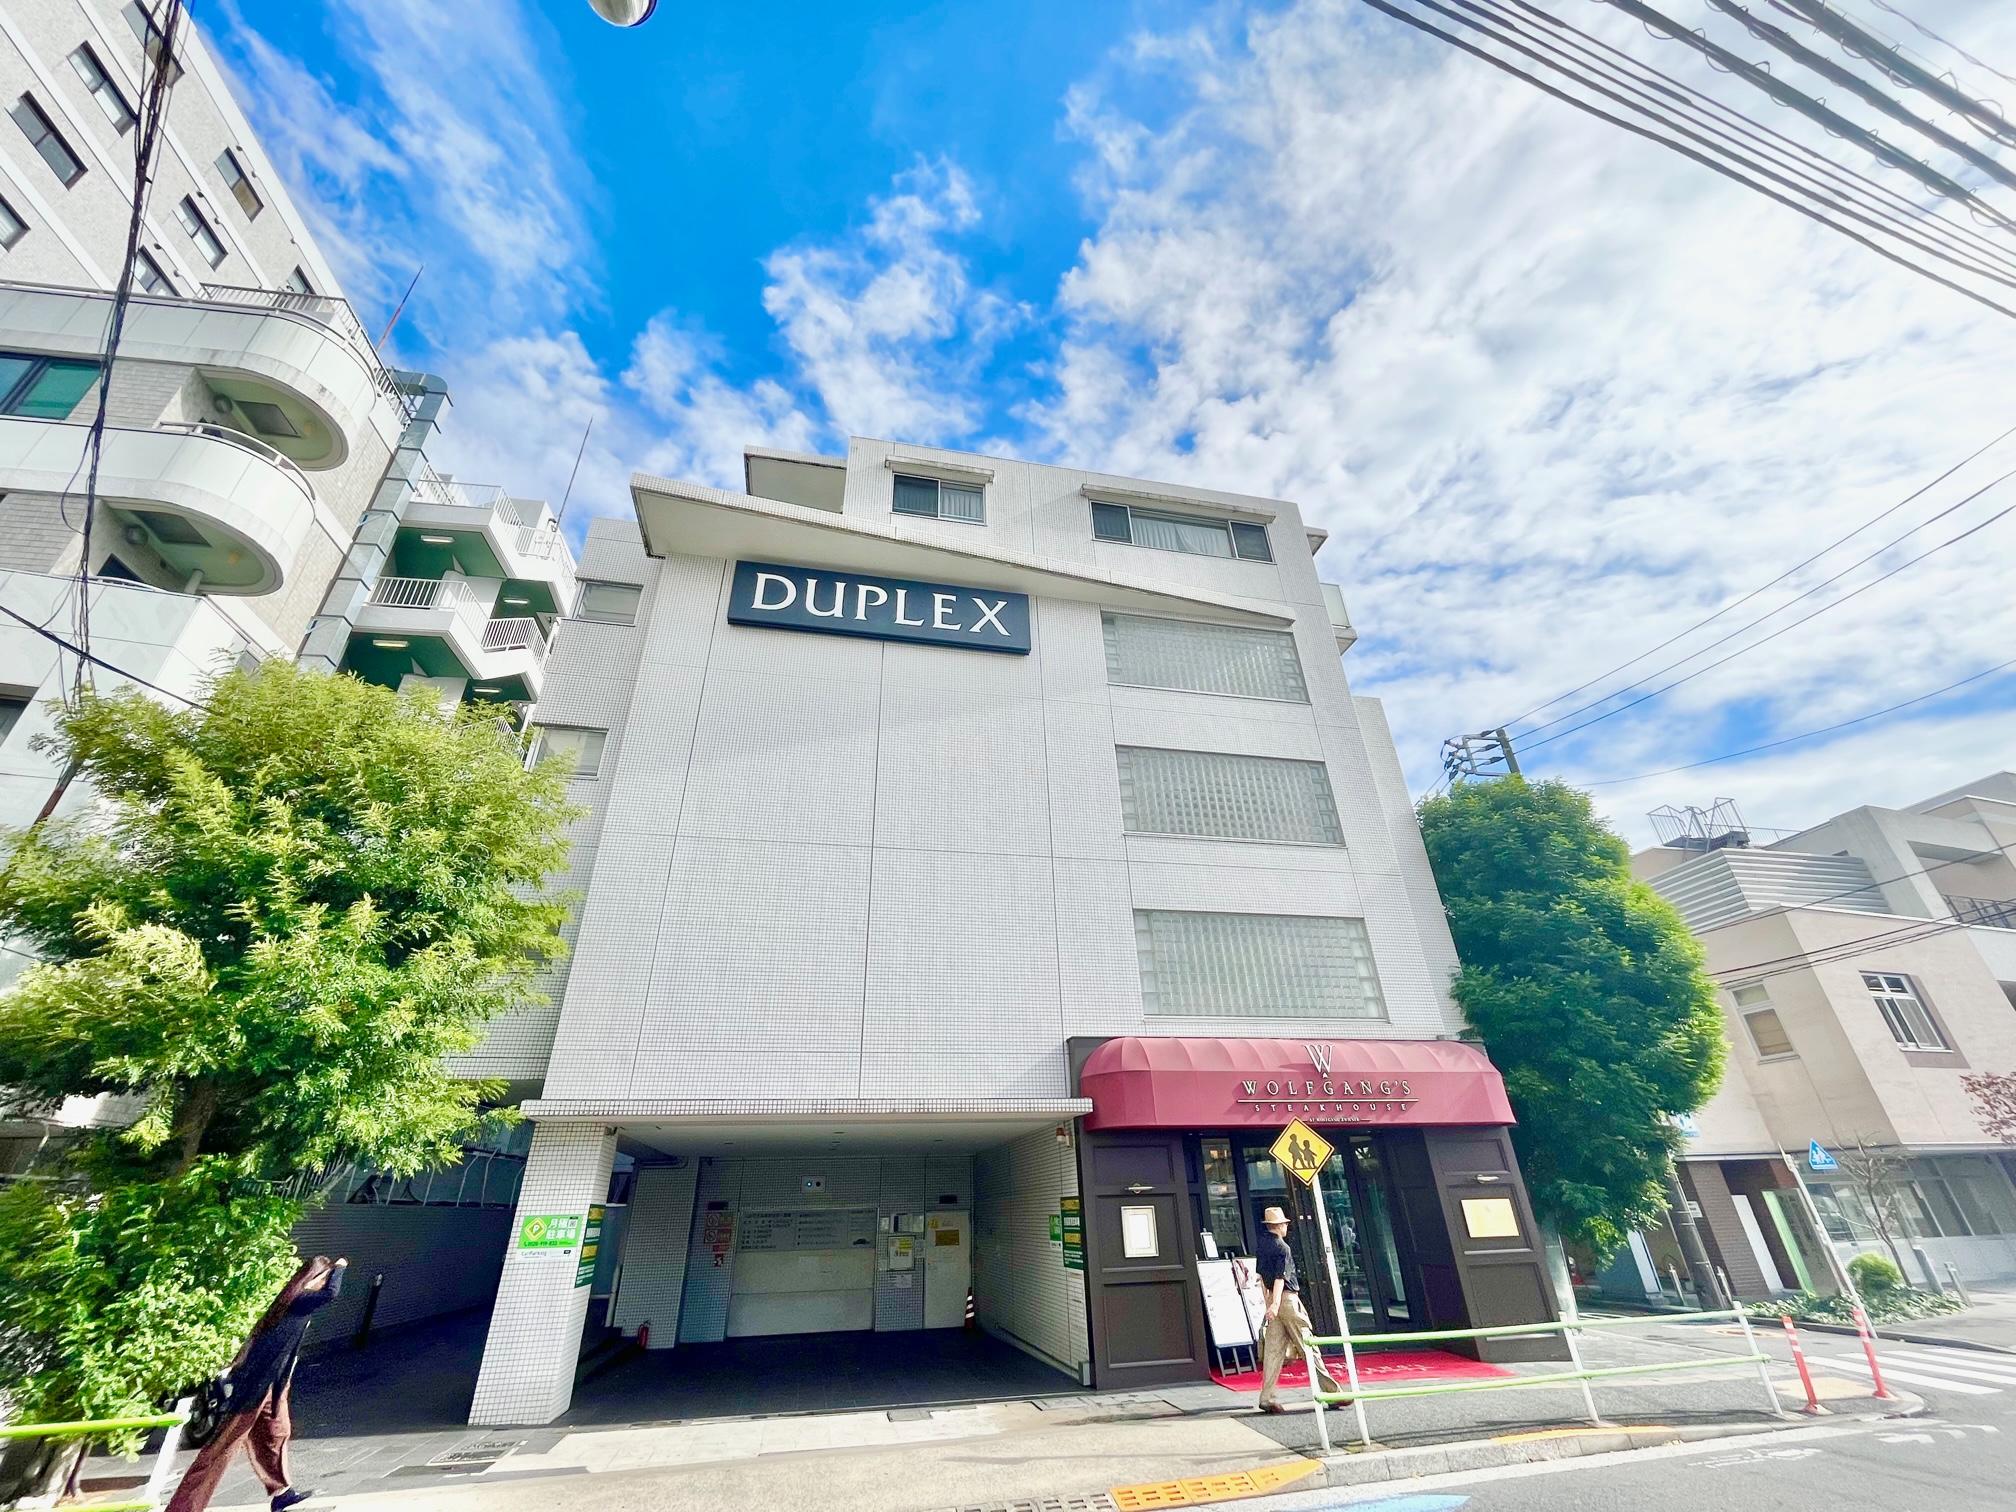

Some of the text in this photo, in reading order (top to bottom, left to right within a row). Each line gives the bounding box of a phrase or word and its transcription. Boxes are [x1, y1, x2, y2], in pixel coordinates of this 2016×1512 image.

[750, 572, 1012, 637] DUPLEX
[1302, 1044, 1335, 1073] W
[1242, 1080, 1411, 1096] WOLFGANG'S
[1254, 1102, 1408, 1112] STEAKHOUSE
[548, 1218, 568, 1229] 月極
[545, 1228, 576, 1240] 駐車場
